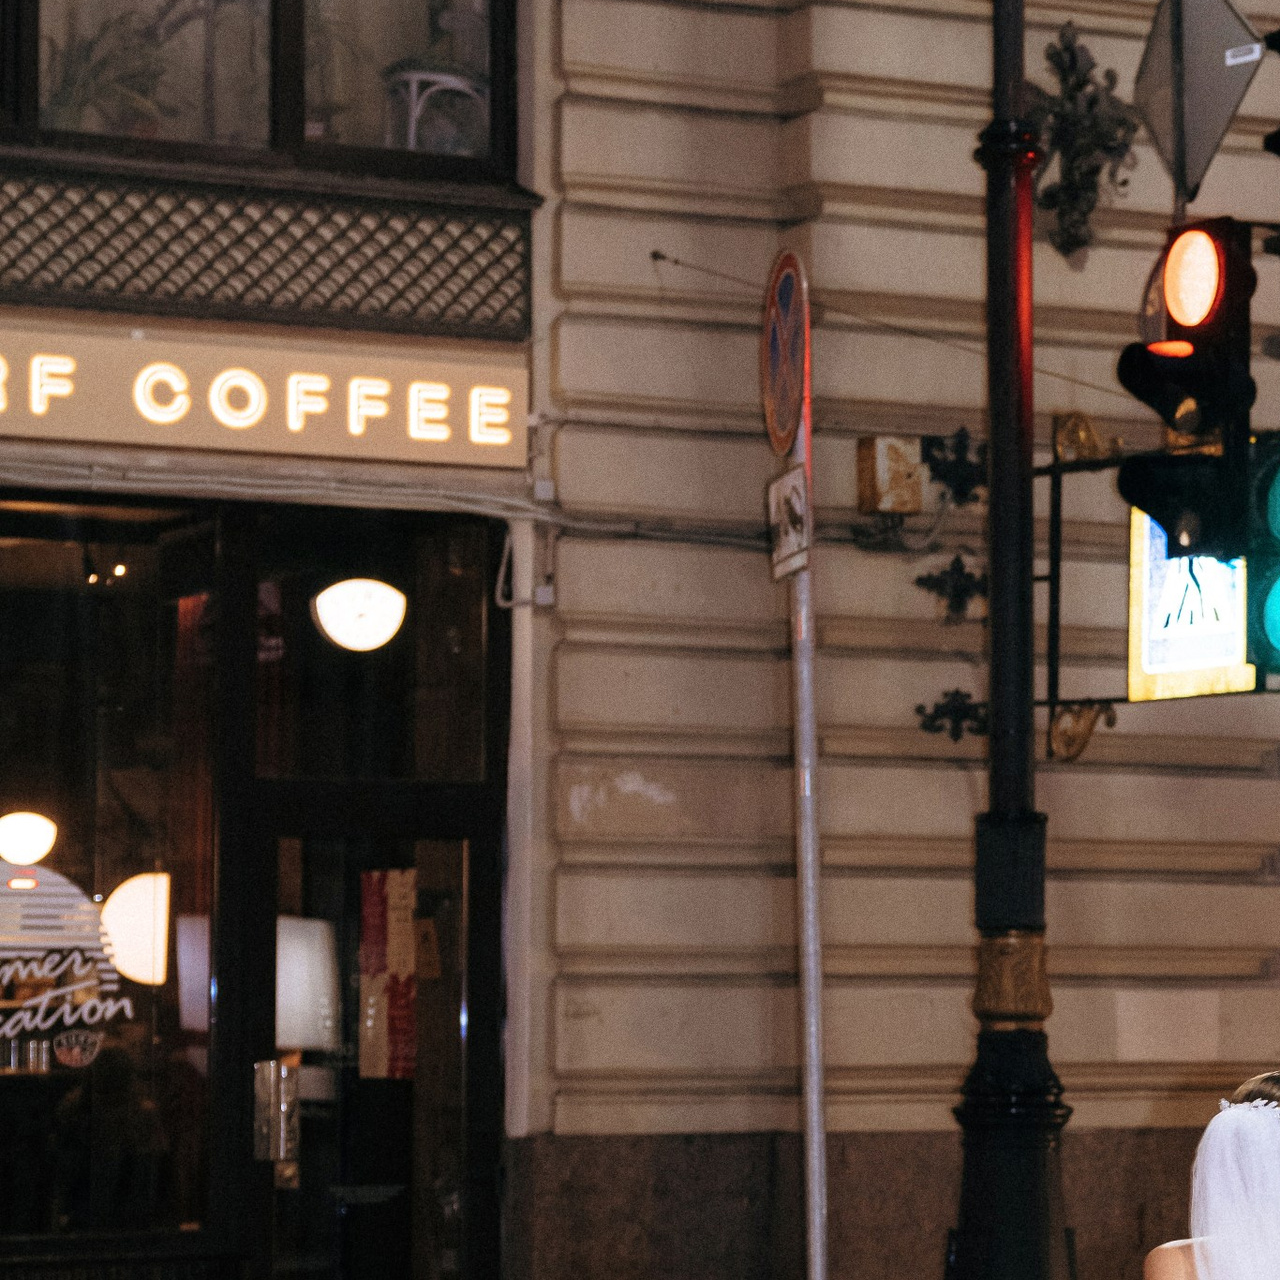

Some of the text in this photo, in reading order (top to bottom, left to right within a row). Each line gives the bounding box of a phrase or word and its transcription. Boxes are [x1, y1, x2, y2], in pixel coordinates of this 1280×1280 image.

[0, 353, 513, 445] F COFFEE
[0, 979, 134, 1039] ation
